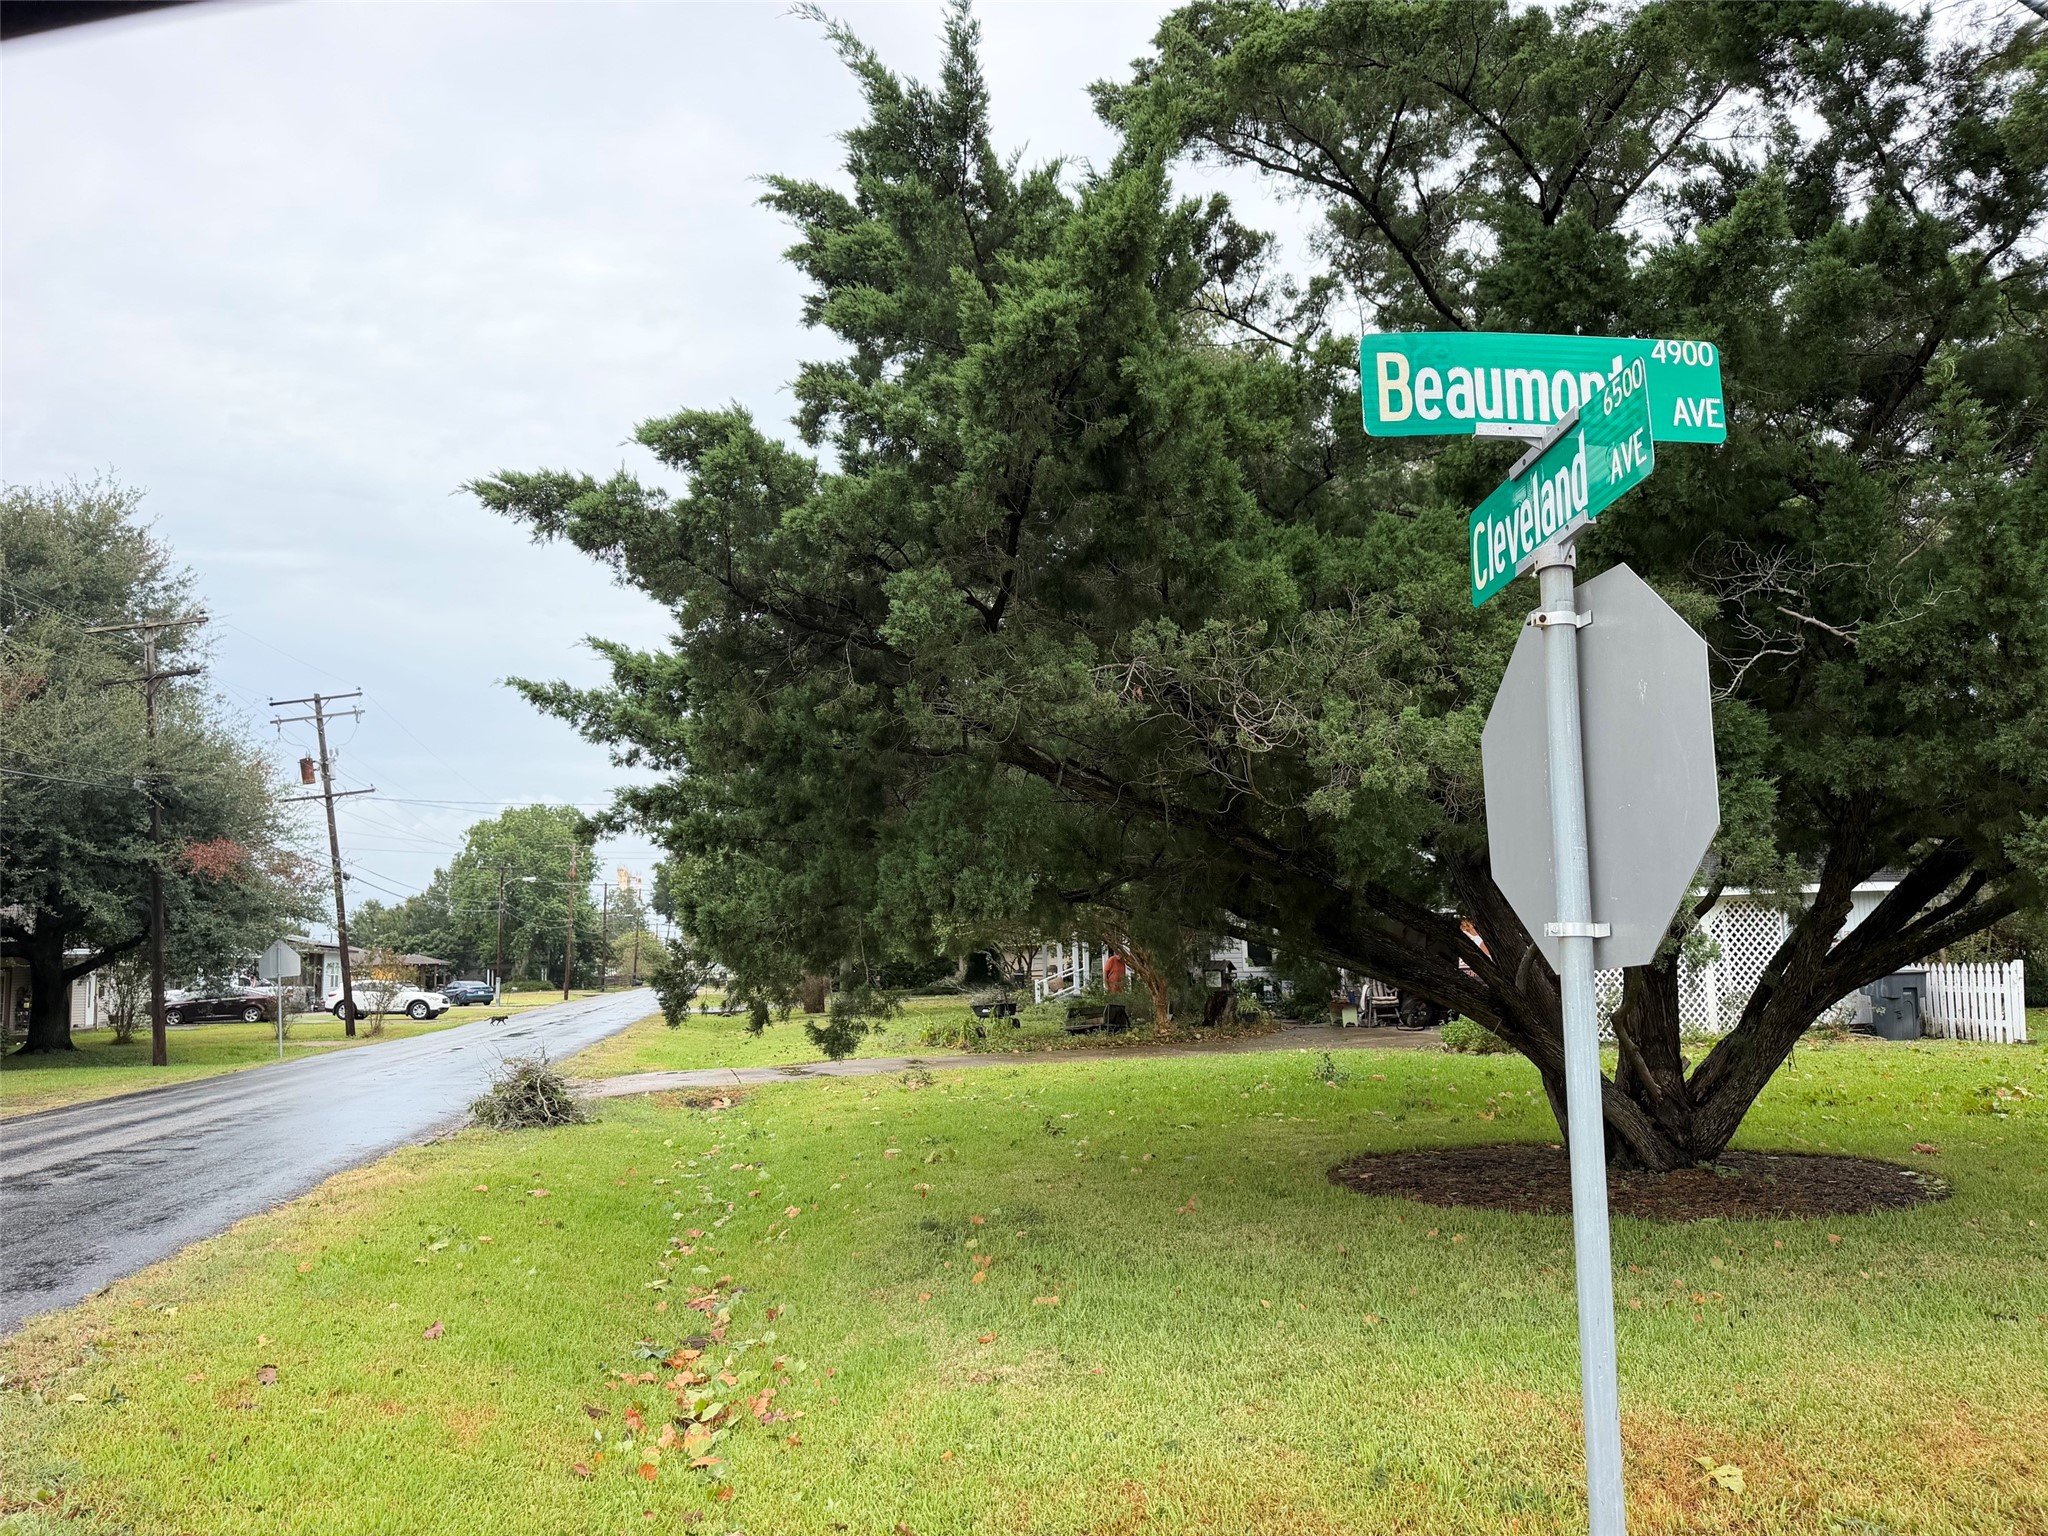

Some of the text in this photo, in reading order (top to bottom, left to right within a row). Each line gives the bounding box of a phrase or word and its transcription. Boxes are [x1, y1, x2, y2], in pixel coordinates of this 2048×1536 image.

[1650, 339, 1714, 367] 4900
[1603, 358, 1643, 416] 6500
[1672, 397, 1725, 429] AVE
[1471, 428, 1648, 591] Cleveland AVE
